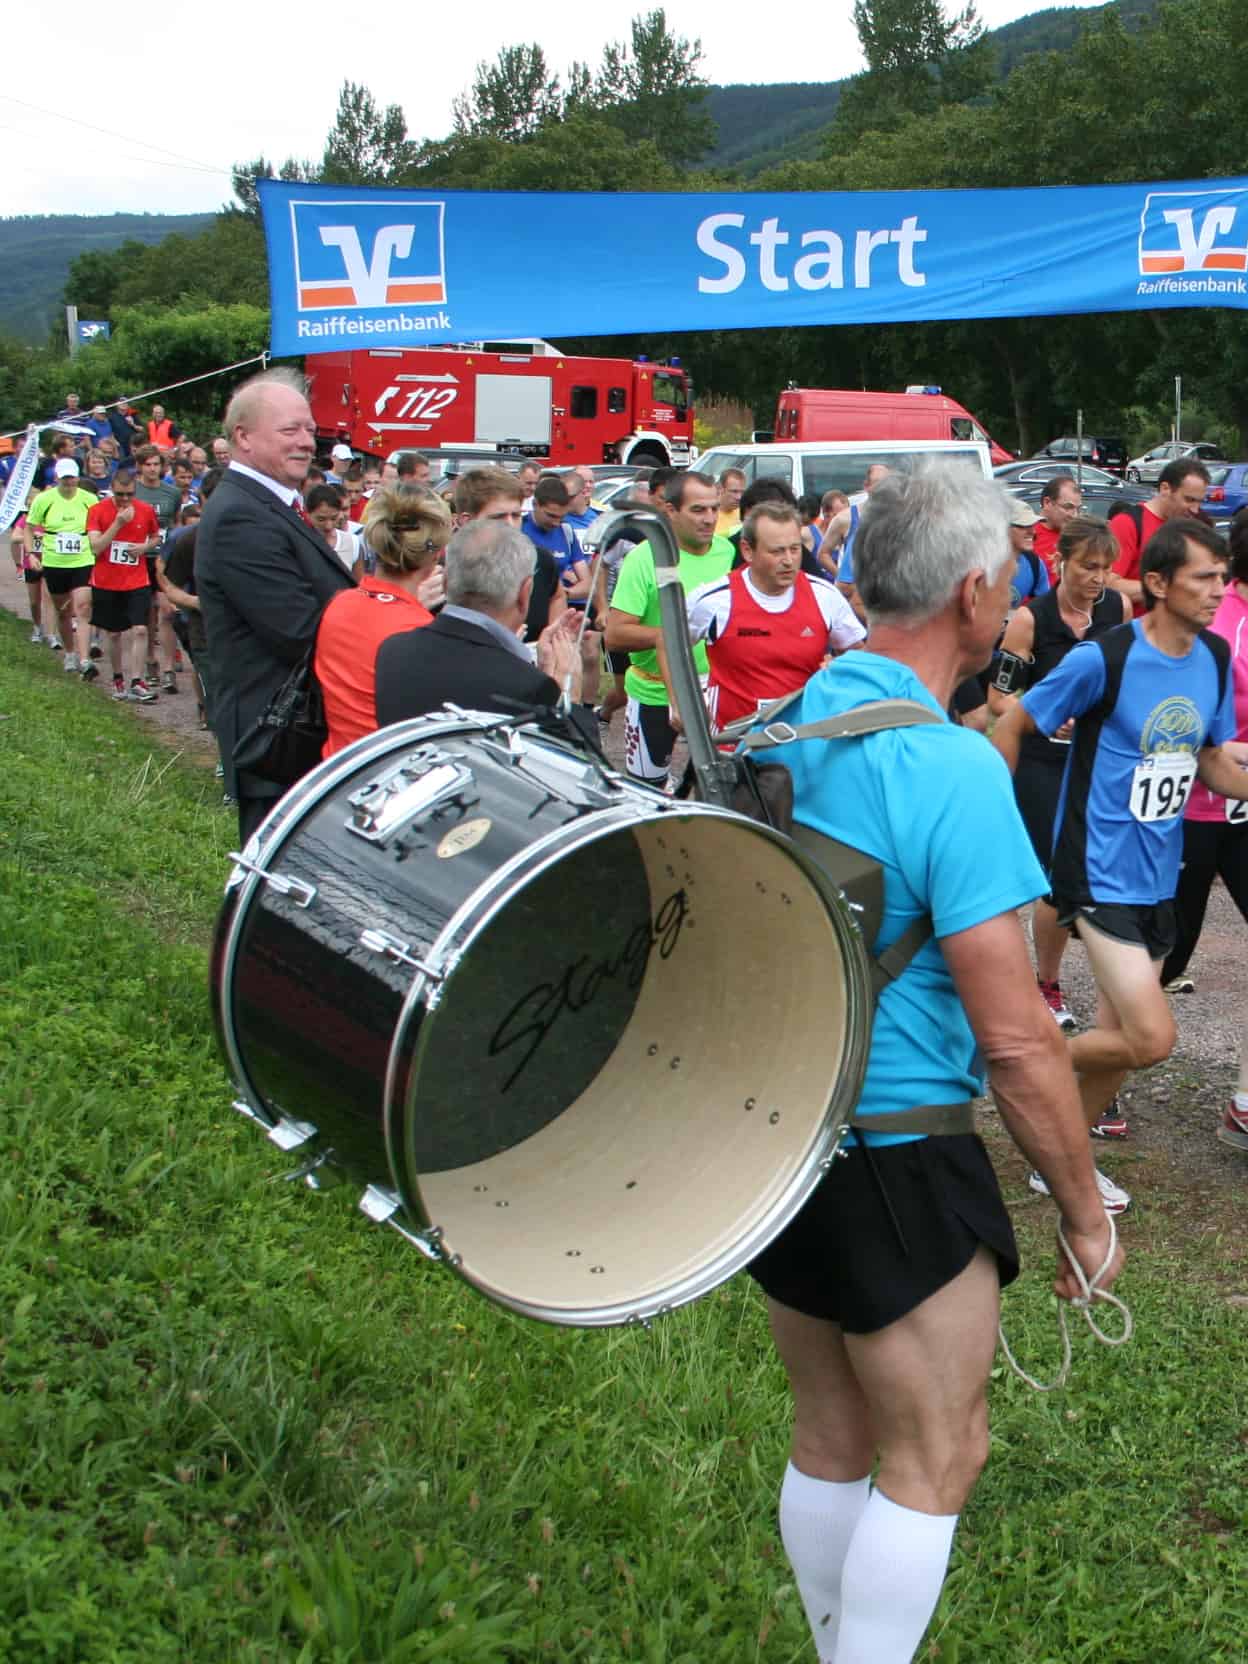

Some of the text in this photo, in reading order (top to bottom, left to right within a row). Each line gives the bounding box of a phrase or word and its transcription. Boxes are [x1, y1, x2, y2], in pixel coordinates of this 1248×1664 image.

[696, 213, 928, 294] Start
[1136, 275, 1247, 295] Raiffeisenbank
[297, 312, 452, 337] Raiffeisenbank
[396, 387, 458, 418] 112
[58, 540, 81, 553] 144
[1139, 774, 1191, 818] 195
[488, 886, 690, 1095] Stagg
